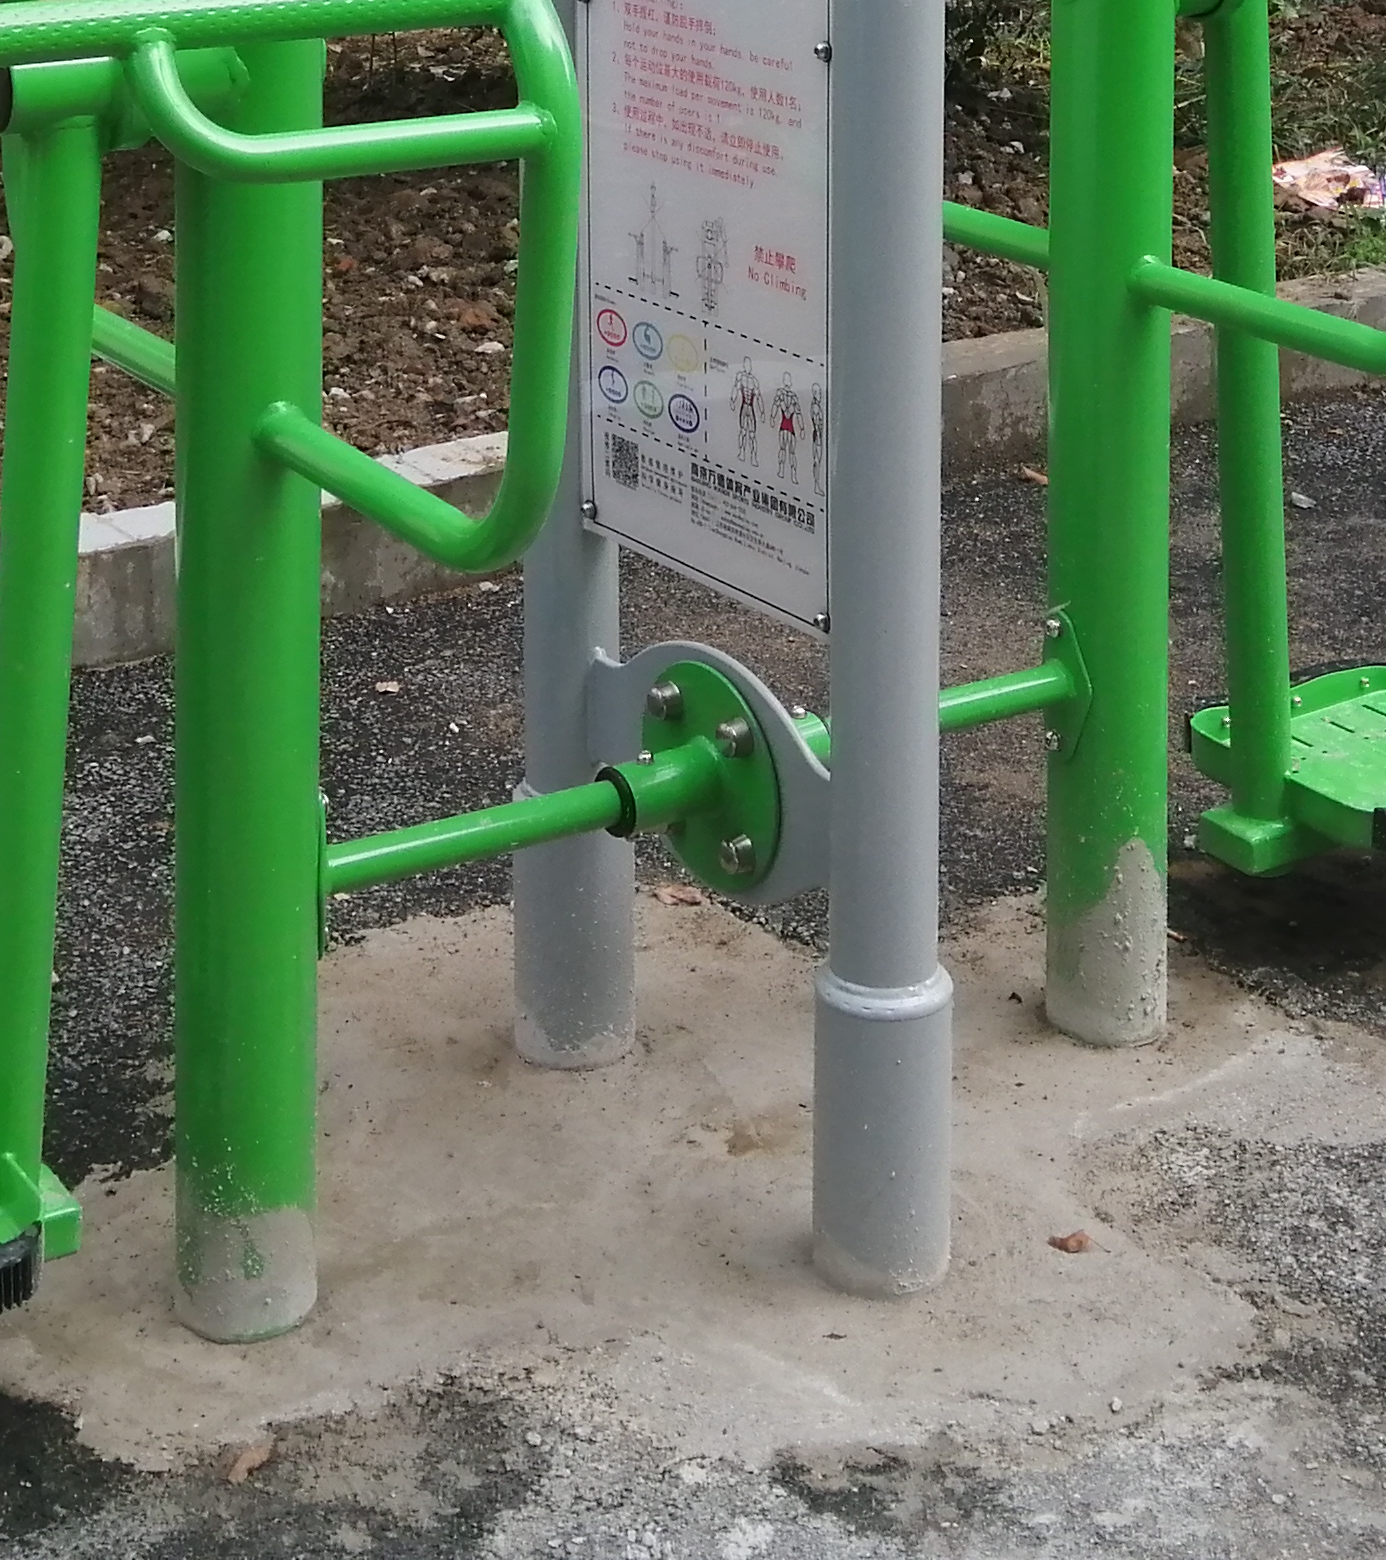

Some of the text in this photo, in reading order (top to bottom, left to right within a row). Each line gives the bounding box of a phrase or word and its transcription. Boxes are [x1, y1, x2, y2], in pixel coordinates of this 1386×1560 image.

[623, 40, 636, 51] not
[639, 42, 648, 54] to
[651, 45, 668, 59] drop
[671, 52, 687, 63] your
[643, 27, 659, 38] your
[699, 41, 715, 52] your
[749, 50, 758, 63] be
[762, 56, 793, 72] careful
[624, 89, 636, 102] the
[624, 71, 636, 85] The
[788, 117, 802, 129] and
[732, 154, 758, 173] during
[748, 264, 760, 282] No
